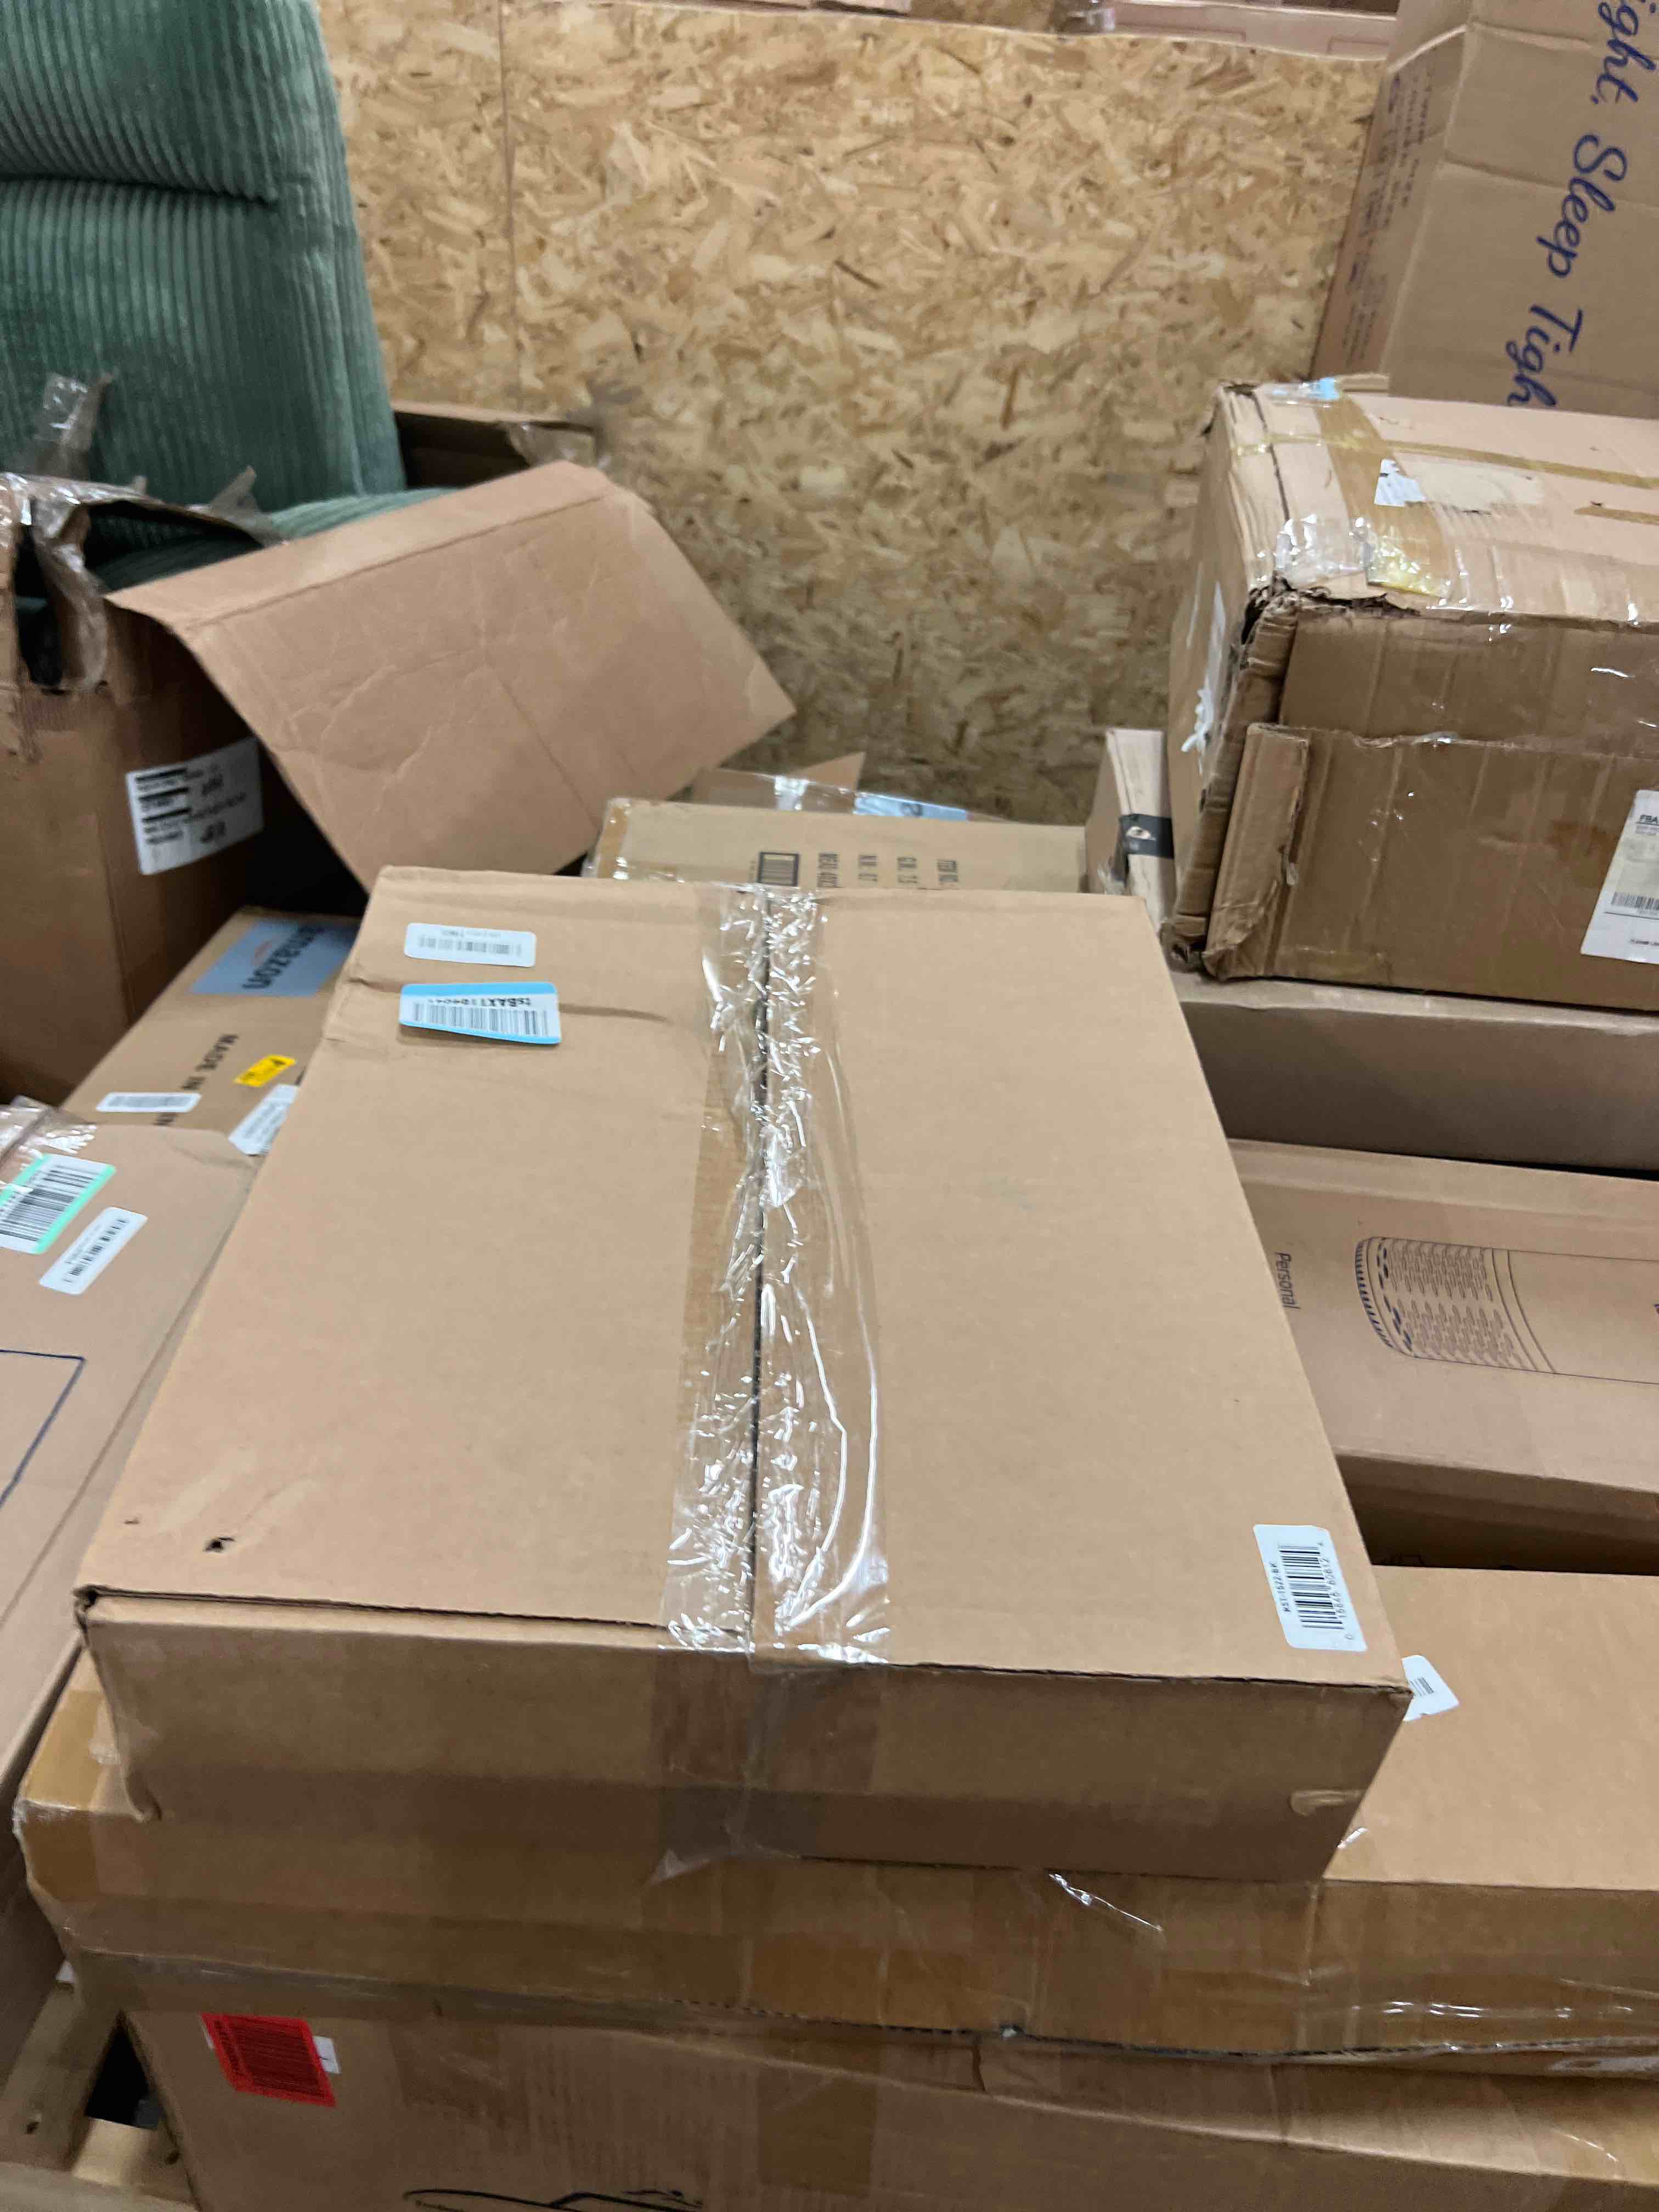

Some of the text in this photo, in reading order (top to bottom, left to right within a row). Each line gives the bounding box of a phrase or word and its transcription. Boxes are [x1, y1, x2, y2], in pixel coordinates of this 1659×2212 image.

[1589, 0, 1657, 104] ght.
[1537, 134, 1628, 277] Sleep
[1273, 1252, 1300, 1310] Personal
